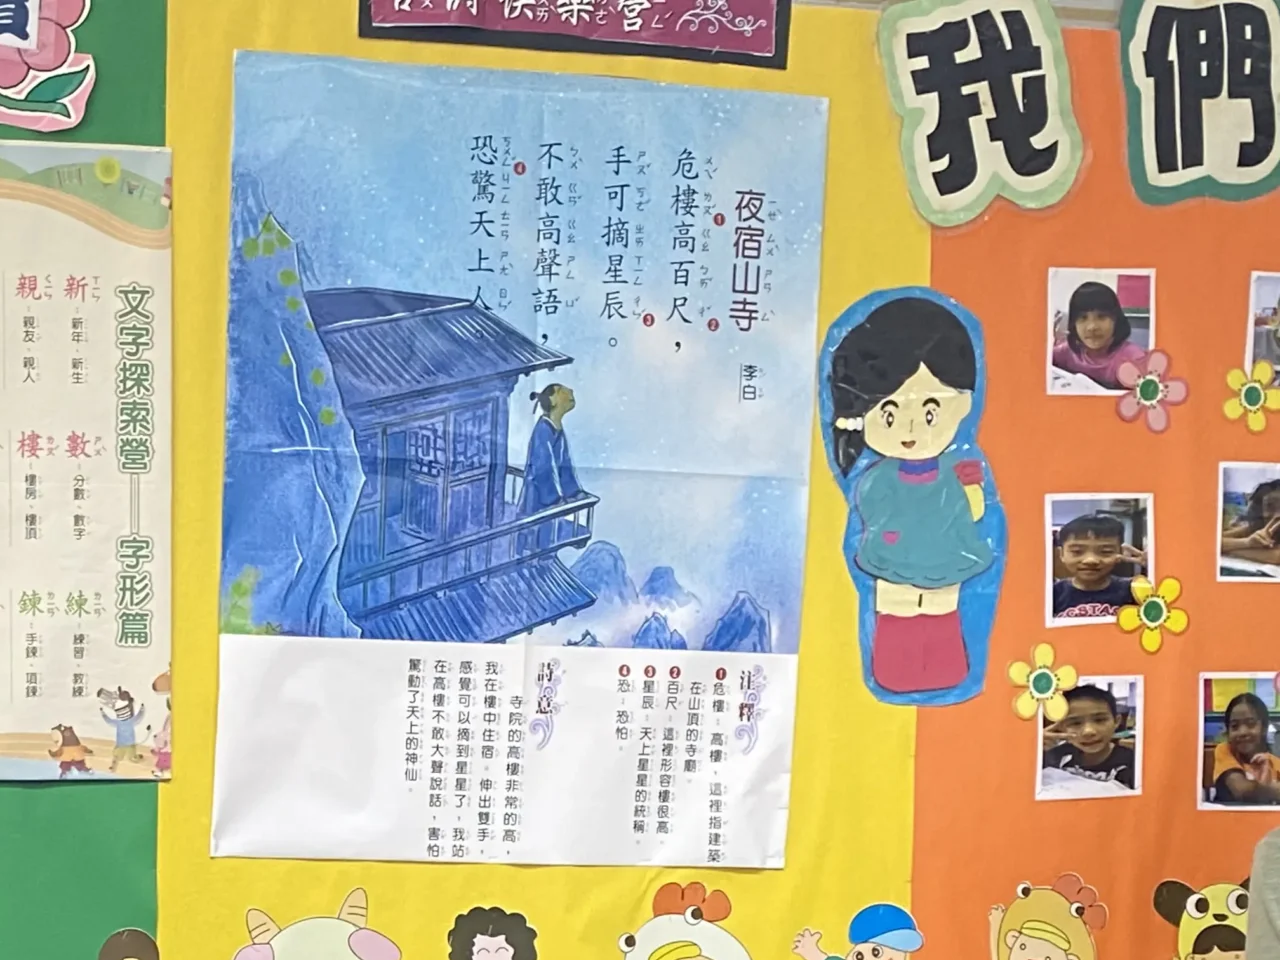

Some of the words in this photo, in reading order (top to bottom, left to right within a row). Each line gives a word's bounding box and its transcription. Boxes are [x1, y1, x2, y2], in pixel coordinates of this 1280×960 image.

[906, 2, 1276, 197] 我們
[728, 190, 766, 333] 夜宿山寺
[742, 364, 758, 402] 李白
[535, 662, 554, 715] 詩意
[738, 670, 755, 722] 注釋
